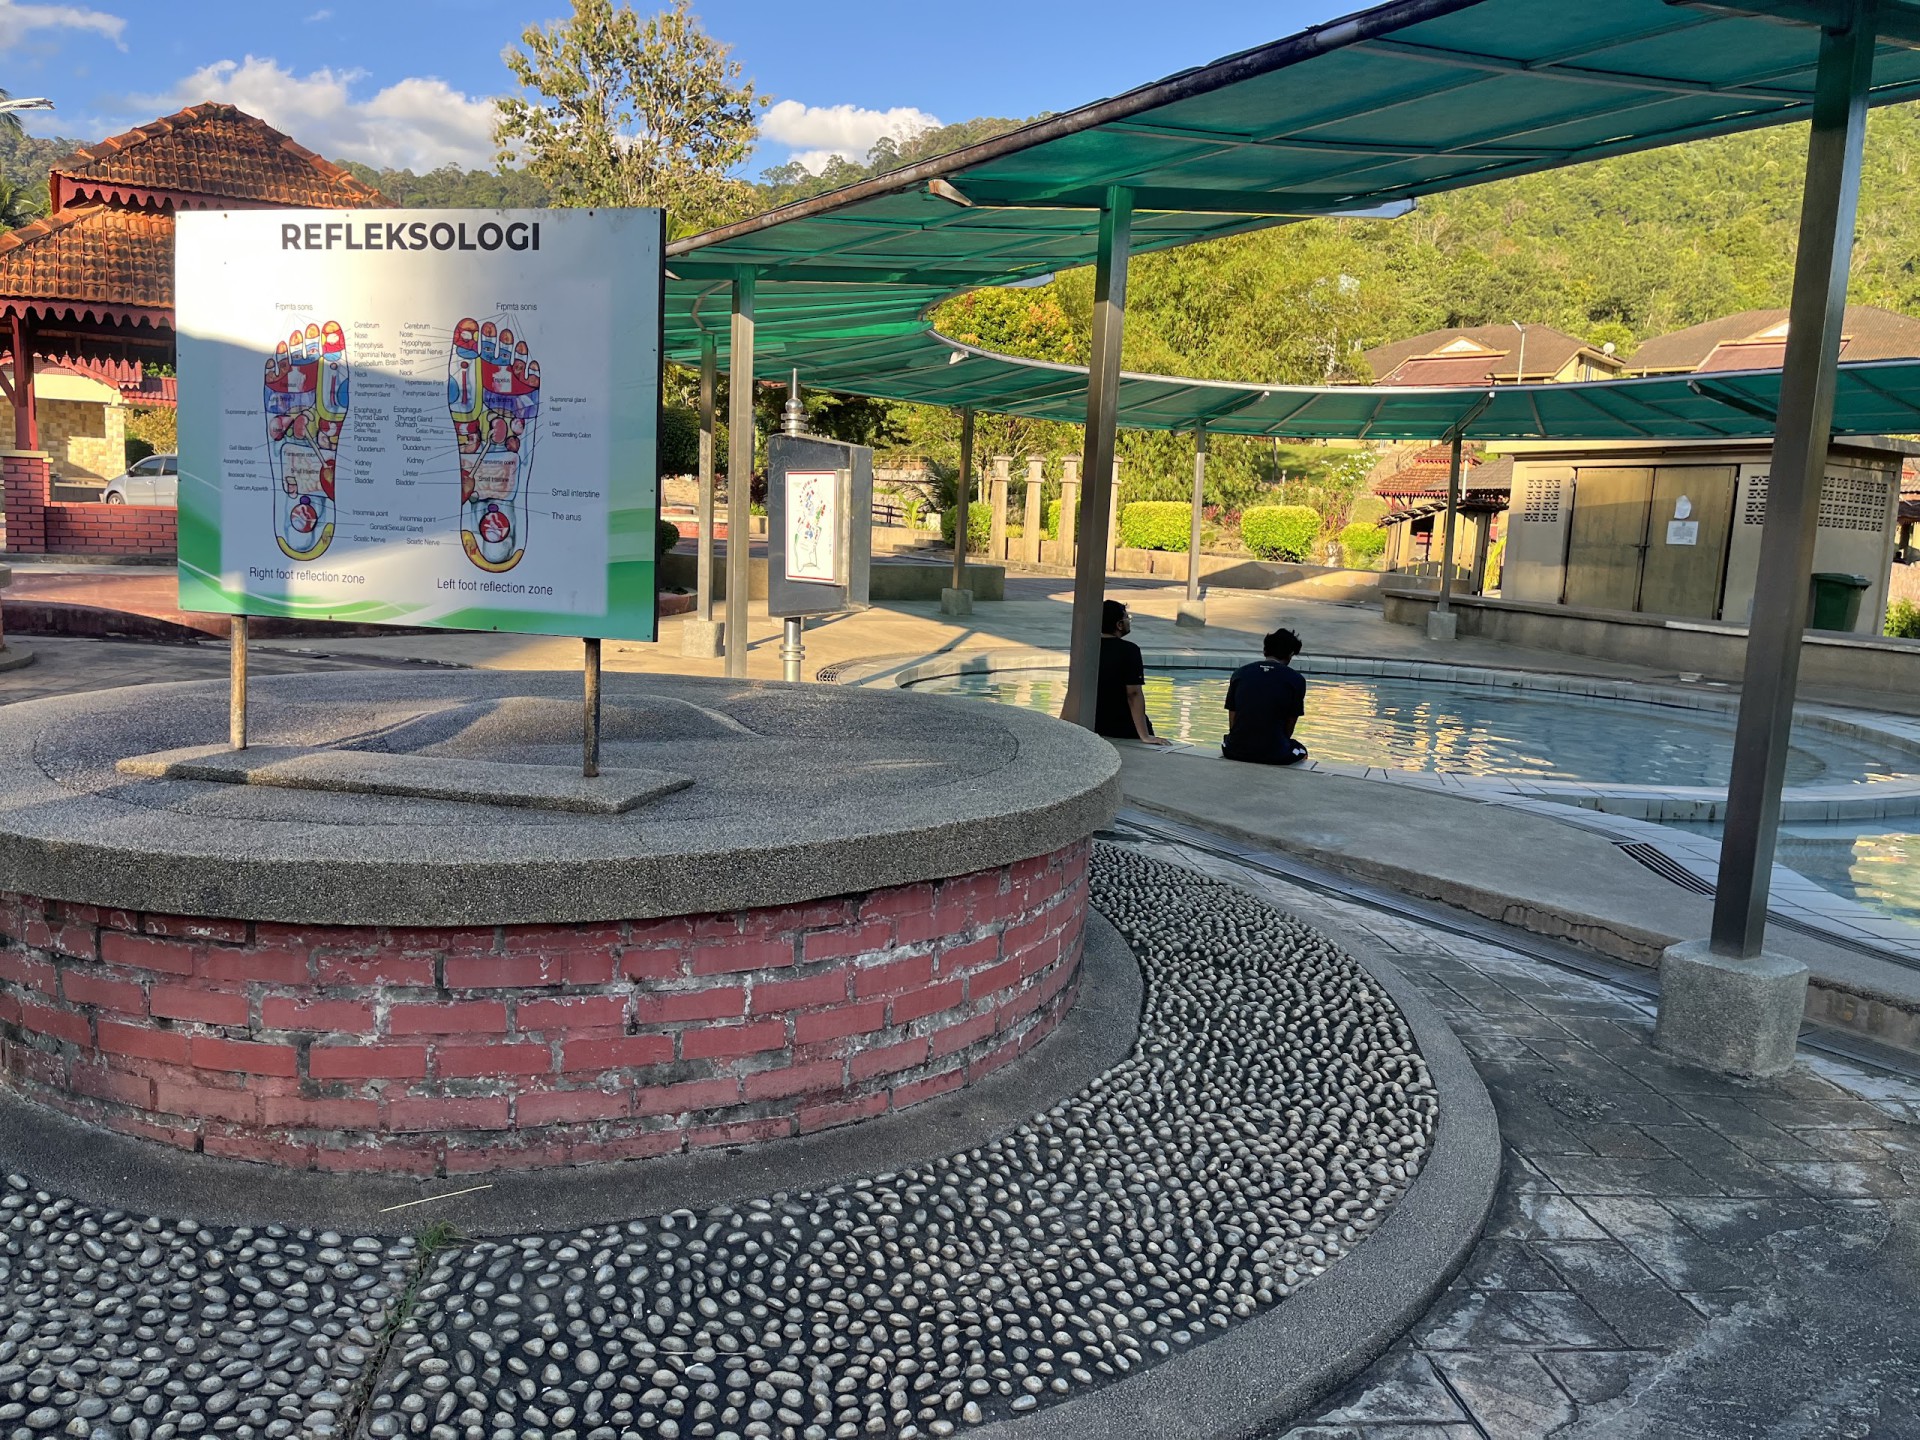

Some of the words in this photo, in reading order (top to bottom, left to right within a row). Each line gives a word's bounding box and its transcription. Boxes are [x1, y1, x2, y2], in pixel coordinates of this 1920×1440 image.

[281, 222, 540, 250] REFLEKSOLOGI
[354, 351, 379, 359] Trigeminal
[394, 406, 422, 414] Esophagus
[552, 488, 570, 497] Small
[571, 489, 600, 498] interstine
[552, 512, 564, 520] The
[250, 567, 273, 580] Right
[276, 568, 293, 580] foot
[297, 569, 339, 582] reflection
[342, 574, 365, 584] zone
[437, 578, 455, 589] Left
[458, 579, 477, 591] foot
[480, 580, 525, 593] reflection
[528, 585, 552, 595] zone
